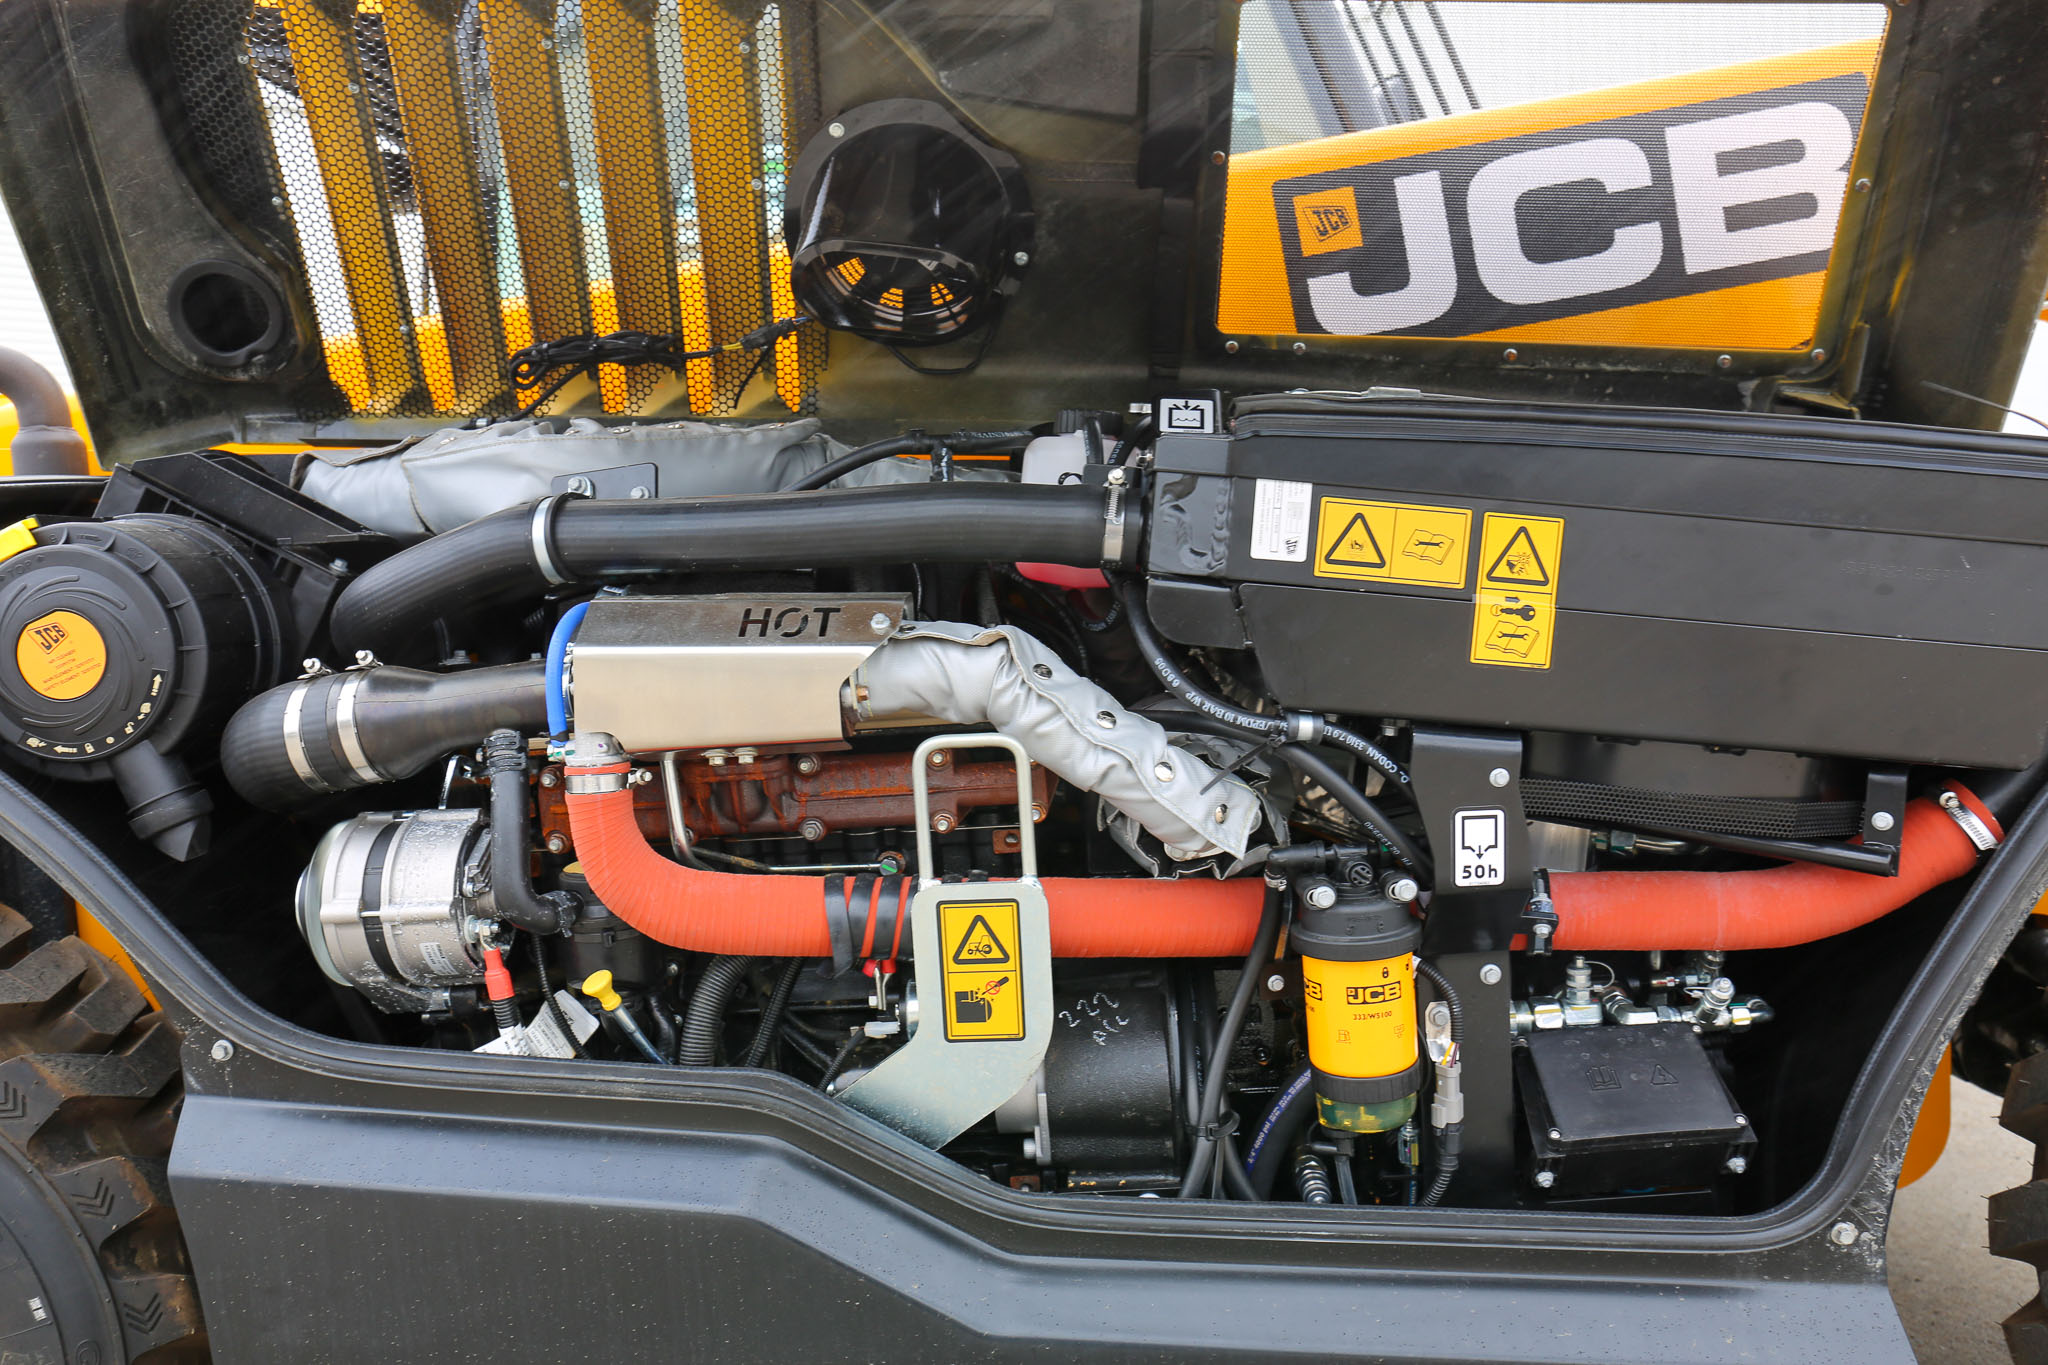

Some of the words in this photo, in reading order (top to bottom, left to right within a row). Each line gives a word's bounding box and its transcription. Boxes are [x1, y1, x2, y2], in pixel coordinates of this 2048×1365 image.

[1306, 101, 1854, 336] JCB
[1312, 207, 1350, 237] JCB
[738, 607, 841, 638] HOT
[34, 624, 65, 650] JCB
[1185, 690, 1205, 707] WP
[1201, 703, 1225, 719] BAR
[1224, 712, 1235, 723] 10
[1345, 734, 1367, 751] 3310
[1366, 745, 1398, 773] CODAN
[1462, 864, 1498, 879] 50h
[1347, 982, 1402, 1004] JCB
[1058, 992, 1120, 1028] 222
